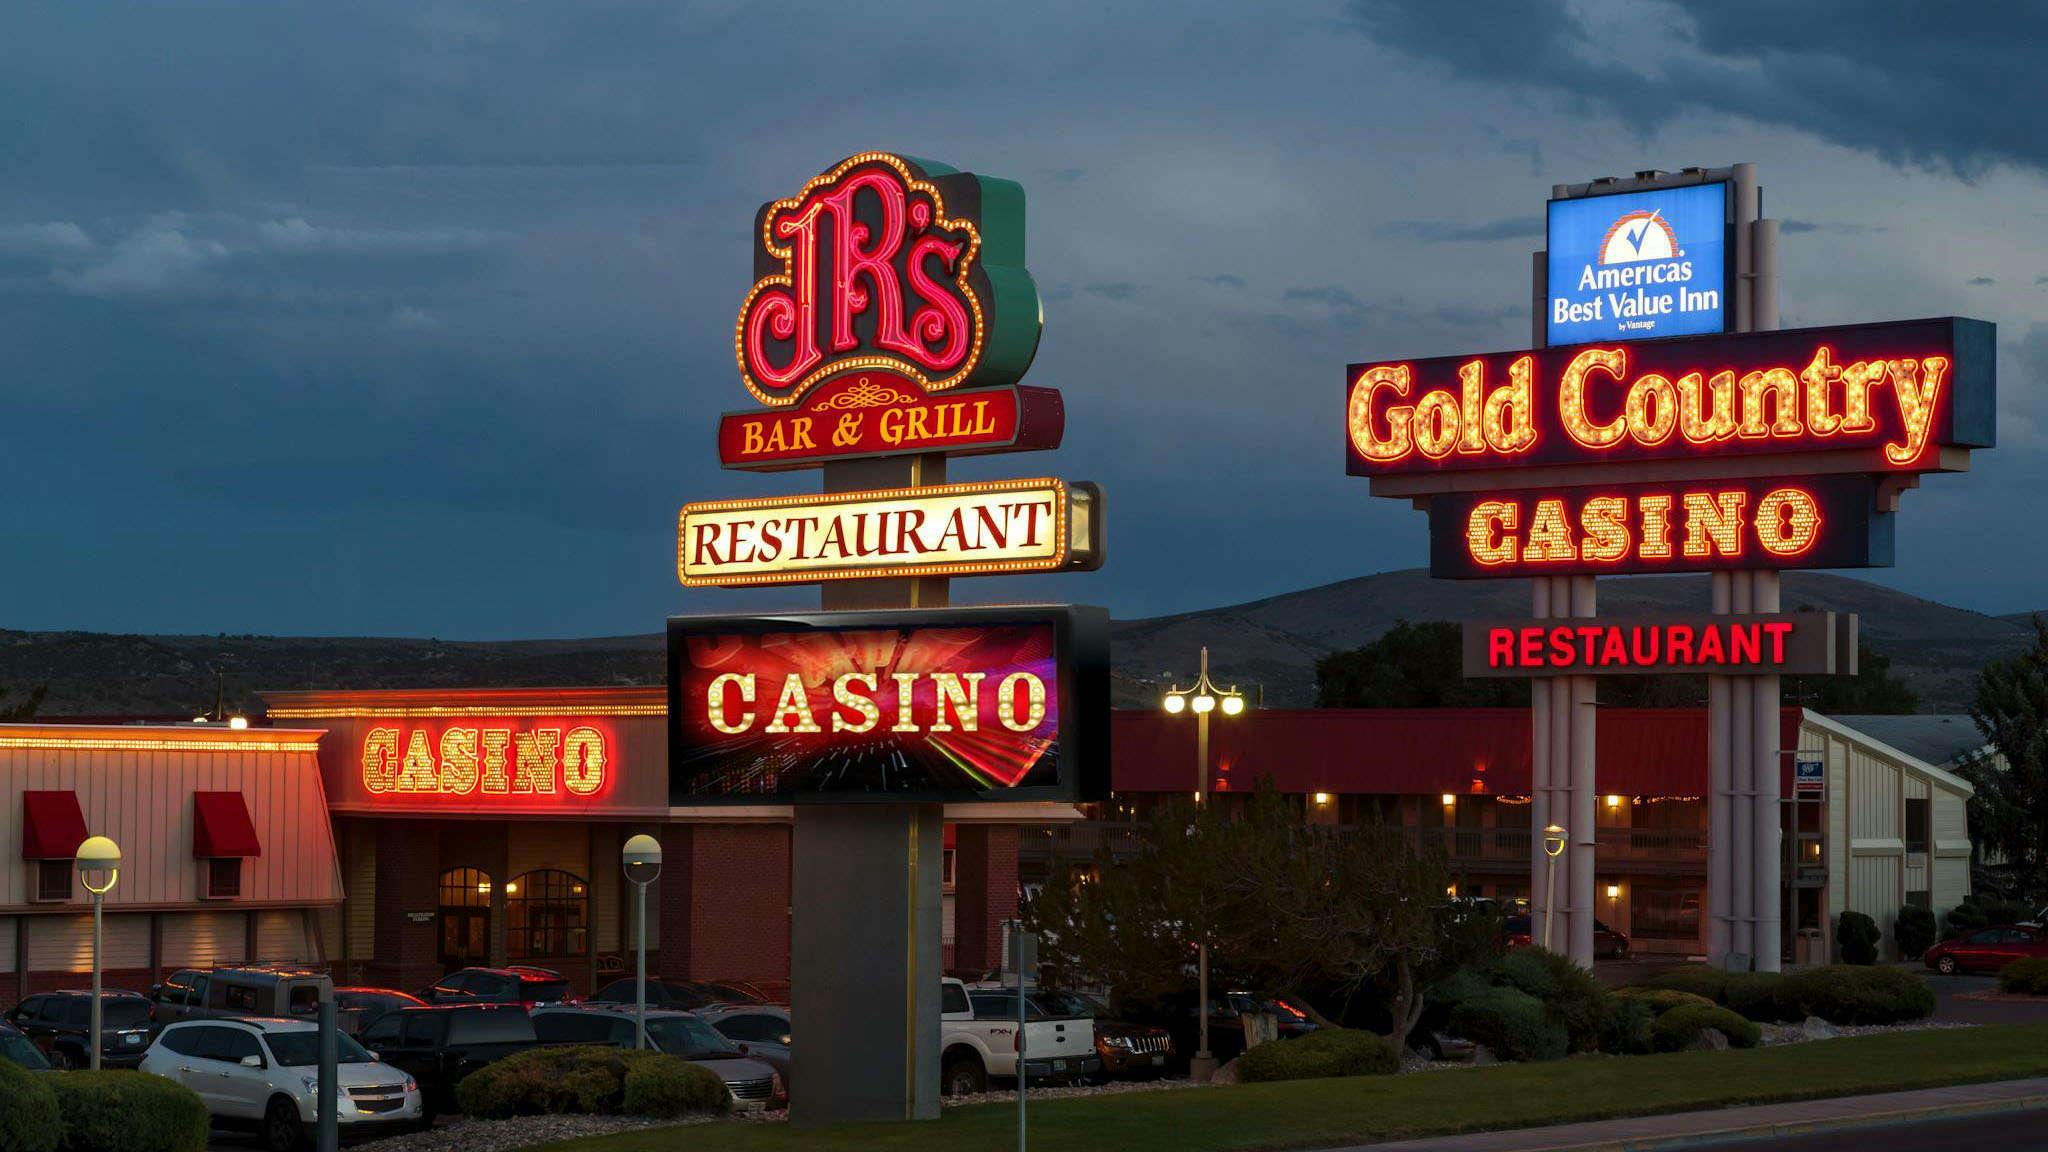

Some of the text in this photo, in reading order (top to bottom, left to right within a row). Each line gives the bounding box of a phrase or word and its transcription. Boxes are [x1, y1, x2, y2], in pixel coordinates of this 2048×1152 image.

[1578, 261, 1693, 291] Americas
[1553, 287, 1718, 324] Best Value Inn
[1618, 320, 1656, 332] by Vantage
[742, 401, 996, 455] BAR & GRILL
[1349, 346, 1948, 465] Gold Country
[690, 500, 1052, 566] RESTAURANT
[1466, 488, 1821, 566] CASINO
[1489, 622, 1793, 667] RESTAURANT
[708, 672, 1046, 734] CASINO
[361, 727, 607, 795] CASINO
